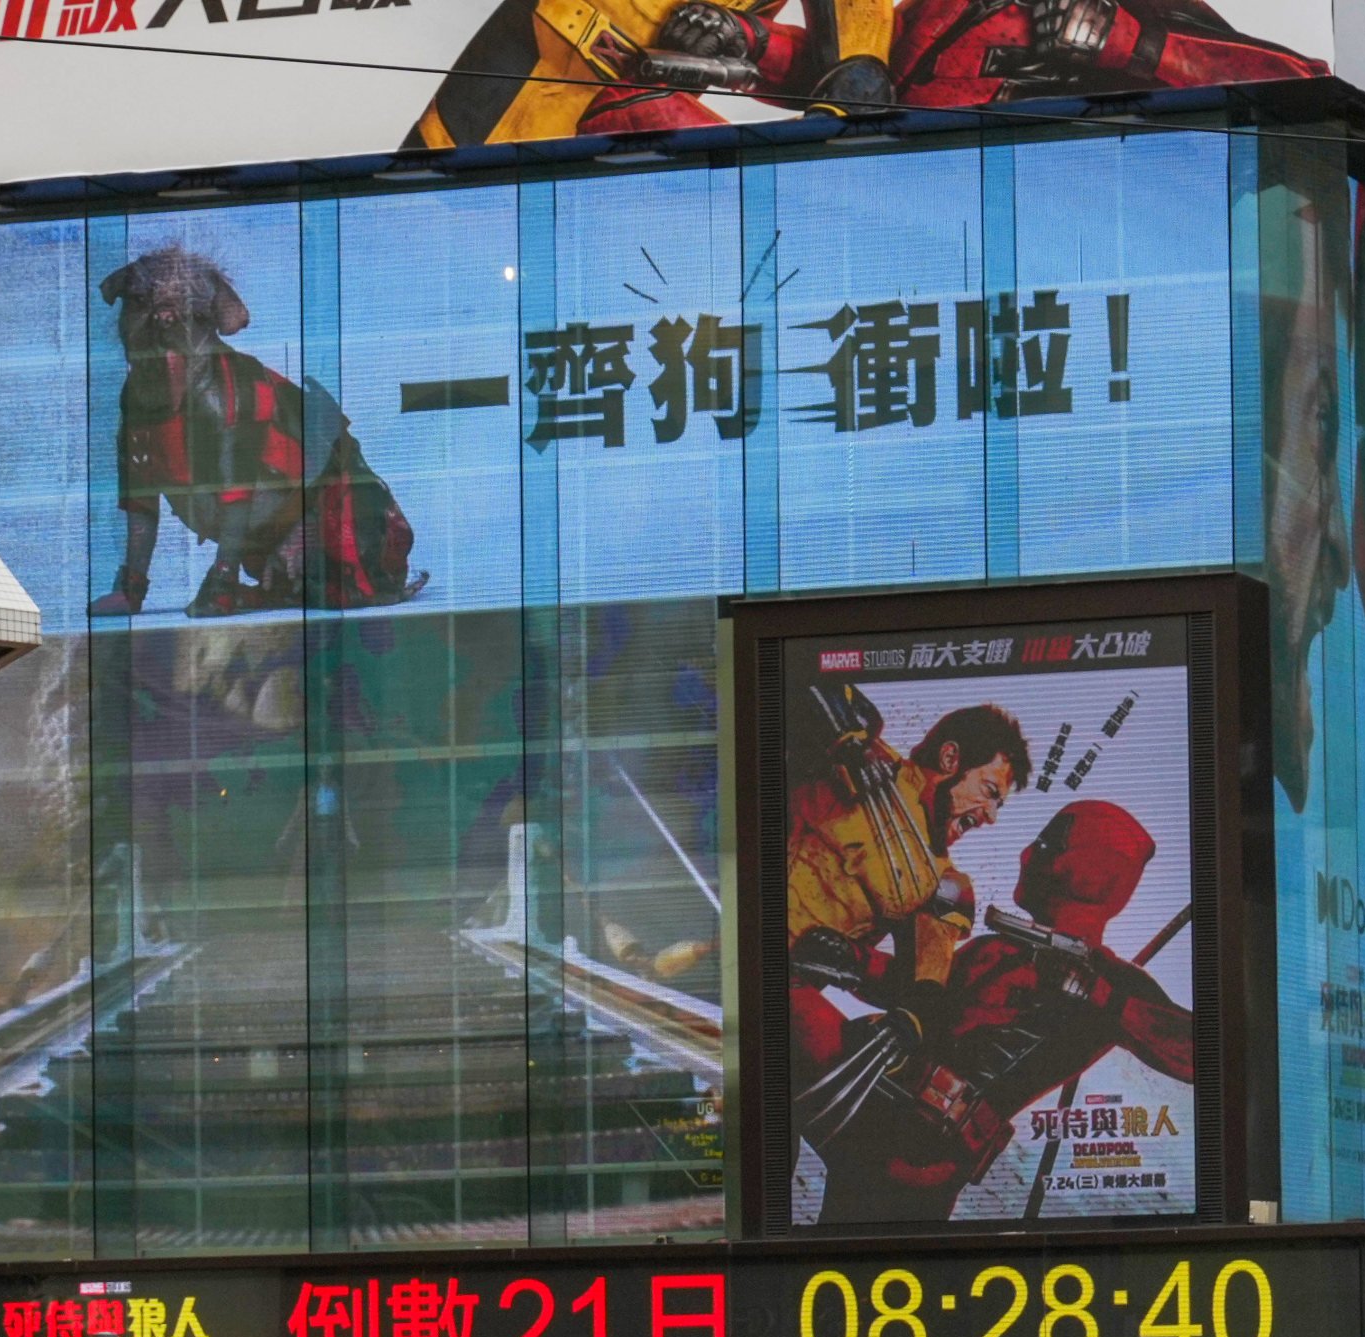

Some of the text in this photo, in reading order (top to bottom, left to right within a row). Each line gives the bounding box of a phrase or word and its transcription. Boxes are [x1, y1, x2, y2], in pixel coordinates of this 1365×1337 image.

[819, 650, 862, 672] MARVEL
[1031, 1105, 1180, 1140] 死侍與狼人
